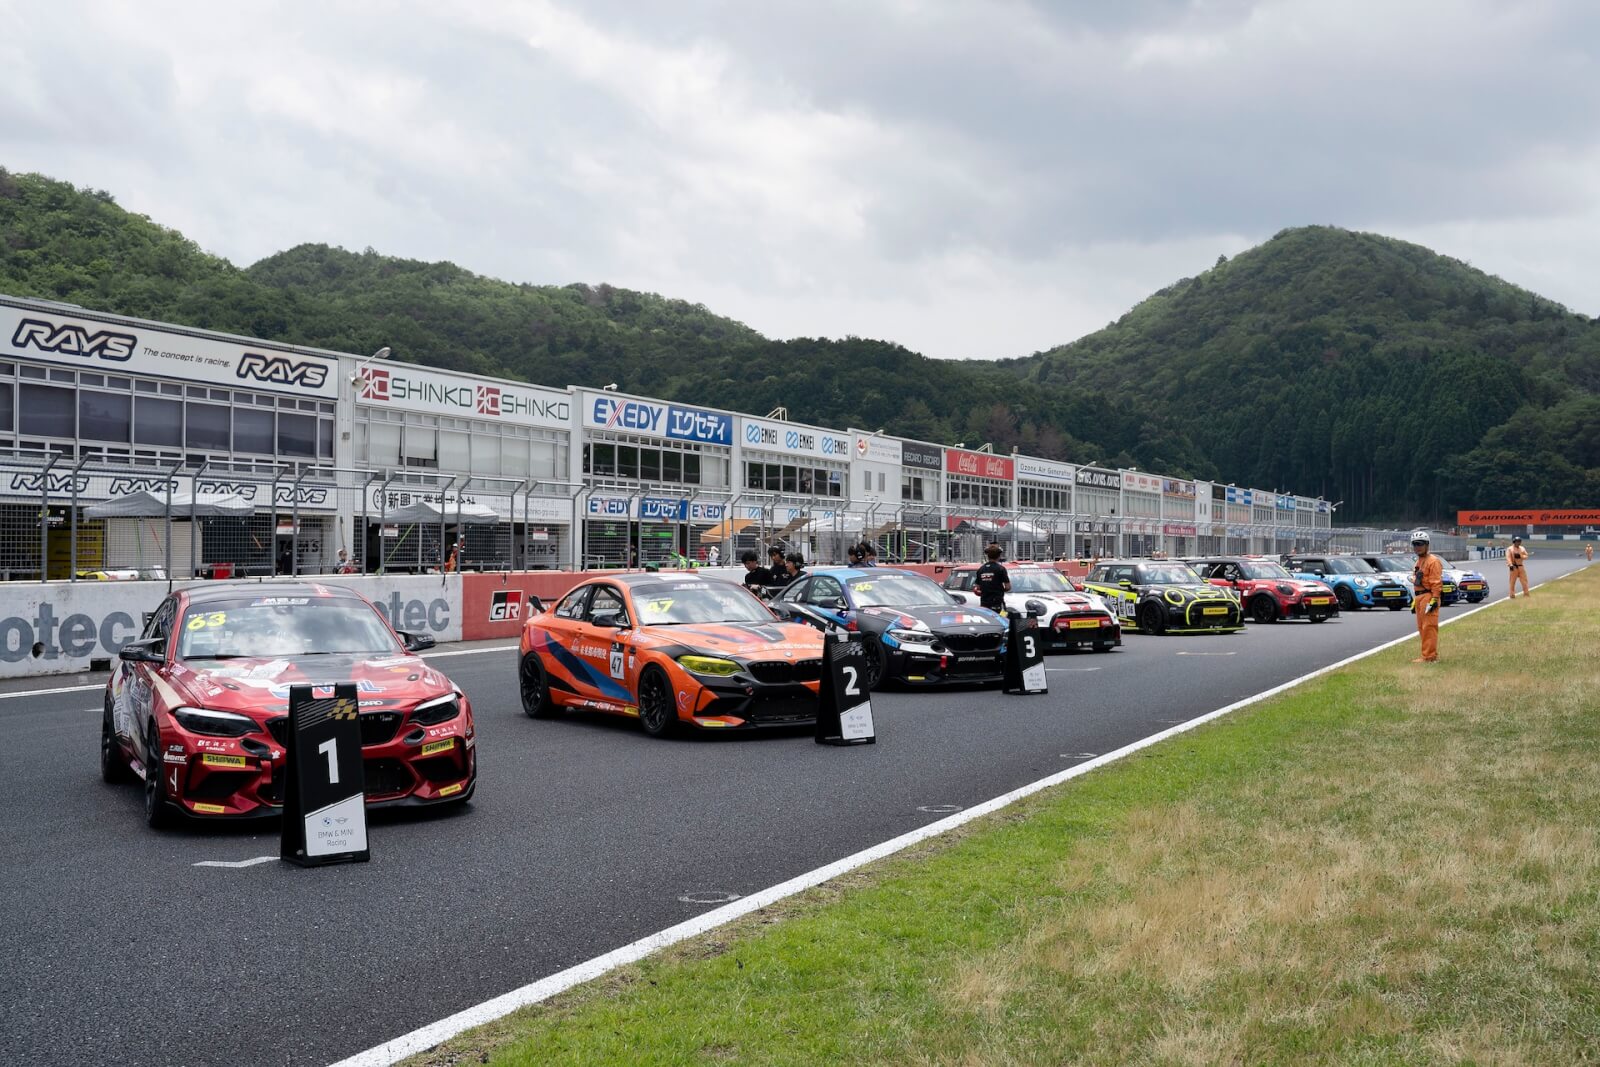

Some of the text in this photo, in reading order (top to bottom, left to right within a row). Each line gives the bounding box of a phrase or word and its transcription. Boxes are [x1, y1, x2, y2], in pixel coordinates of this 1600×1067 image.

[12, 318, 137, 362] RAYS
[143, 347, 159, 356] The
[160, 351, 194, 362] concept
[195, 355, 203, 363] is
[236, 352, 328, 388] RAYS
[392, 377, 472, 408] SHINKO
[502, 394, 570, 421] SHINKO
[593, 398, 664, 431] EXEDY
[671, 410, 726, 441] エクセディ
[10, 473, 89, 493] RAYS
[274, 486, 328, 503] RAYS
[692, 504, 727, 519] EXEDY
[492, 602, 520, 619] GR
[187, 613, 226, 631] 63
[1023, 636, 1036, 658] 3
[611, 655, 622, 674] 47
[842, 666, 860, 696] 2
[318, 737, 340, 784] 1
[317, 830, 333, 838] BMW
[326, 839, 347, 849] Racing
